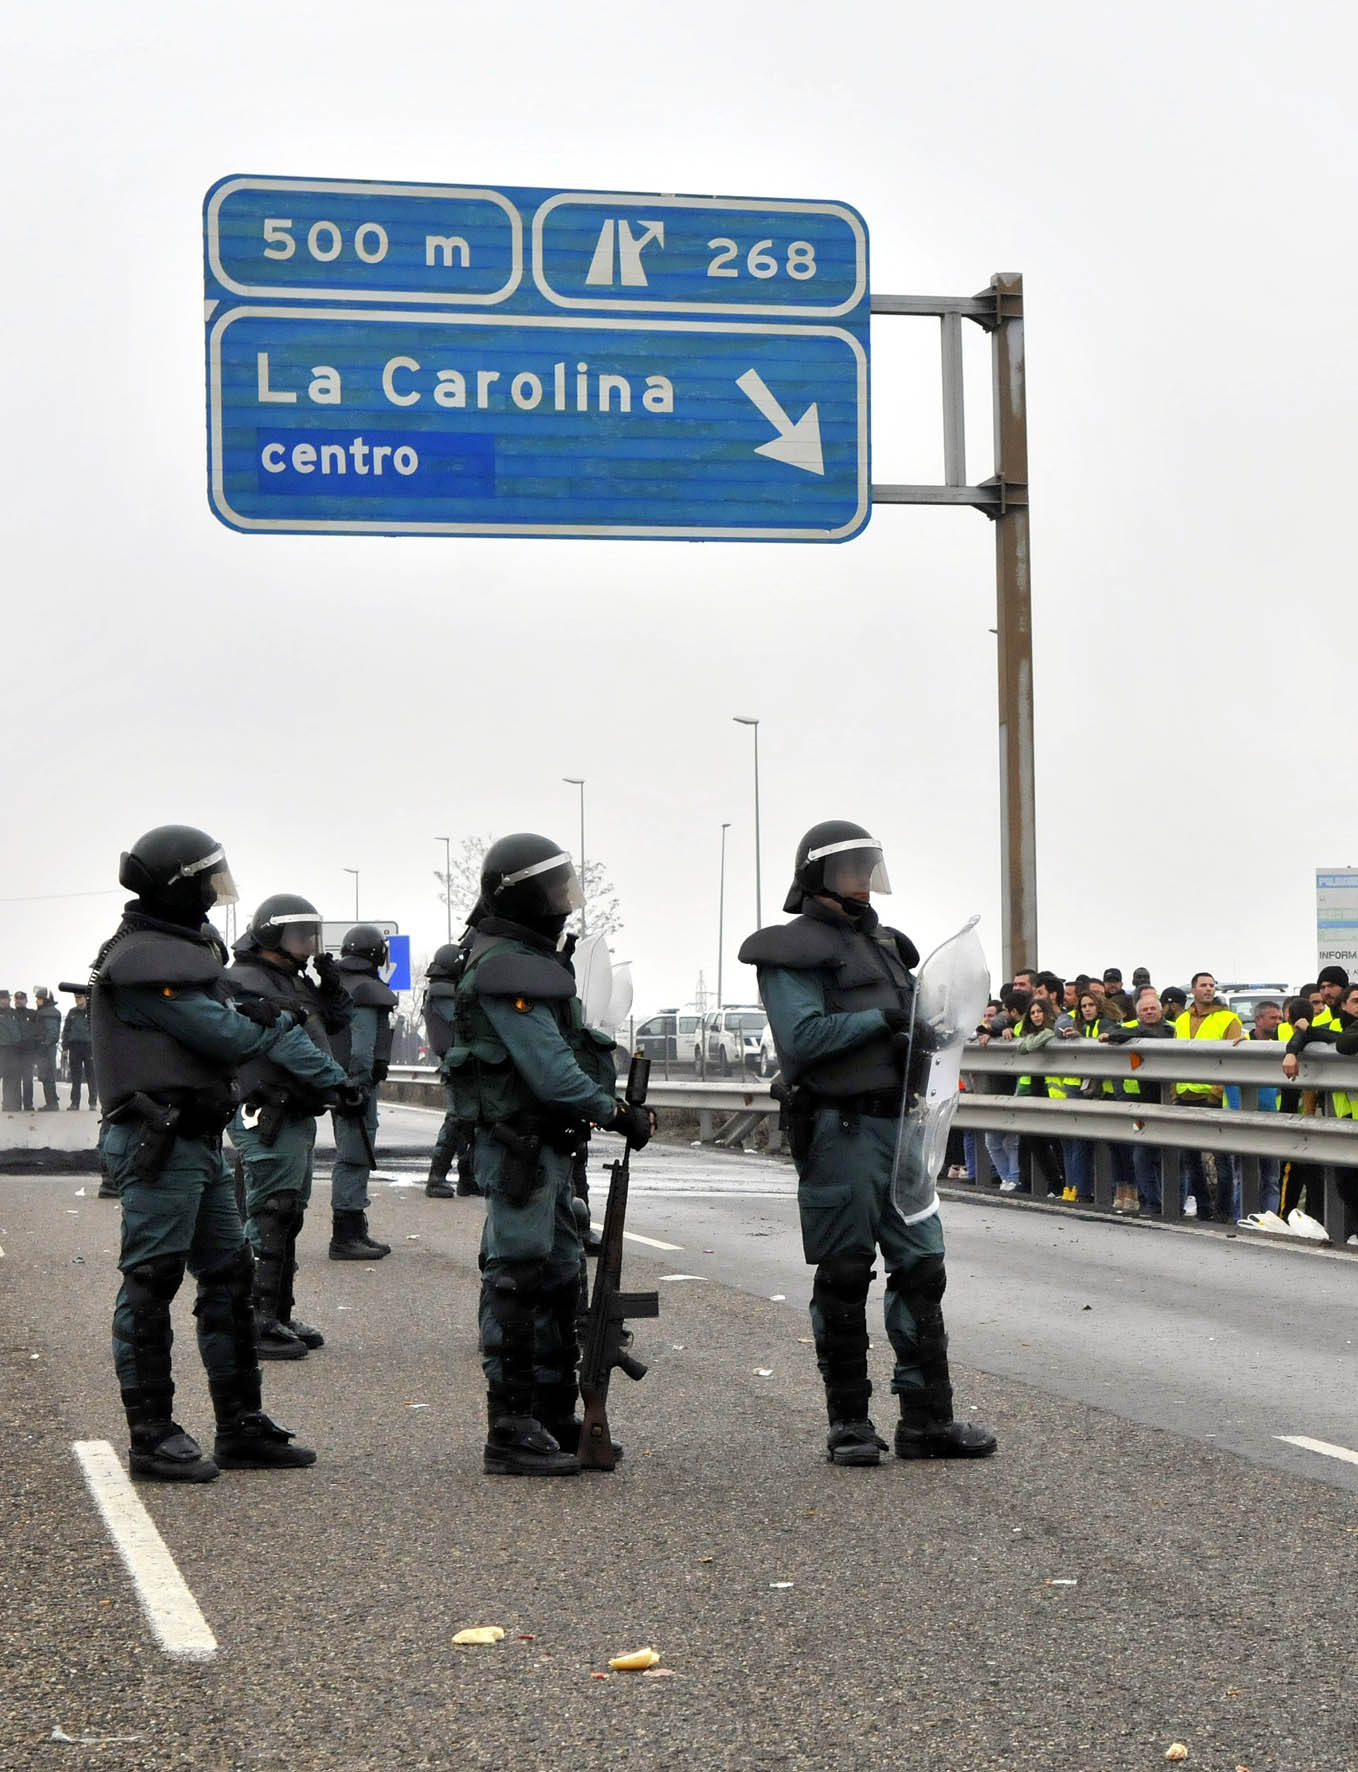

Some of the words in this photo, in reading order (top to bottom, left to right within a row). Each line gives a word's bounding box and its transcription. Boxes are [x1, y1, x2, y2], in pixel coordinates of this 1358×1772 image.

[262, 218, 389, 264] 500
[424, 233, 471, 268] m
[706, 238, 817, 281] 268
[257, 352, 342, 404] La
[382, 356, 675, 413] Carolina
[261, 436, 419, 477] centro
